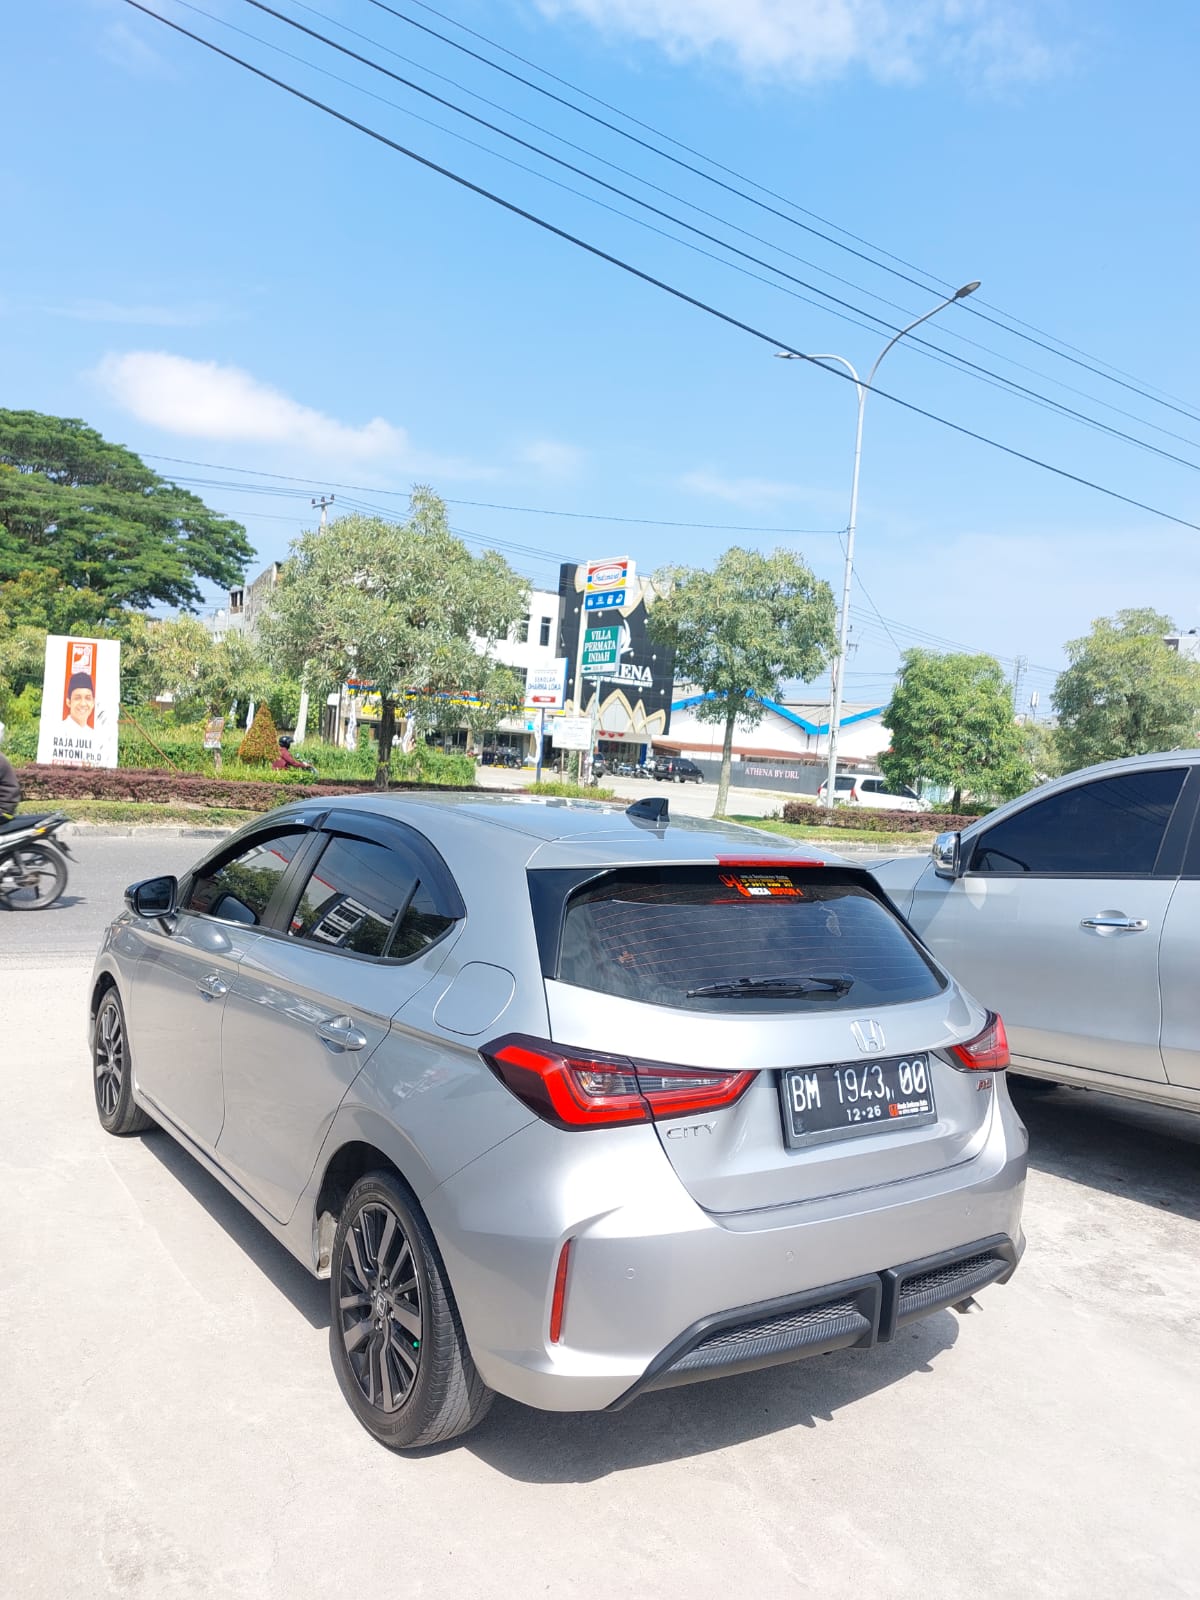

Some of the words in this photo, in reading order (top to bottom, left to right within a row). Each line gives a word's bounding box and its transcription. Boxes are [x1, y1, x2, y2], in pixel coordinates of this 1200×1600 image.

[591, 629, 611, 641] VILLA
[584, 640, 616, 652] PERMATA
[588, 651, 611, 662] INDAH
[53, 737, 73, 748] RAJA
[75, 738, 92, 749] JULI
[745, 767, 773, 777] ATHENA
[774, 769, 784, 778] BY
[791, 1073, 821, 1112] BM
[834, 1065, 885, 1104] 1943
[898, 1060, 927, 1095] 00
[666, 1121, 717, 1139] CITY
